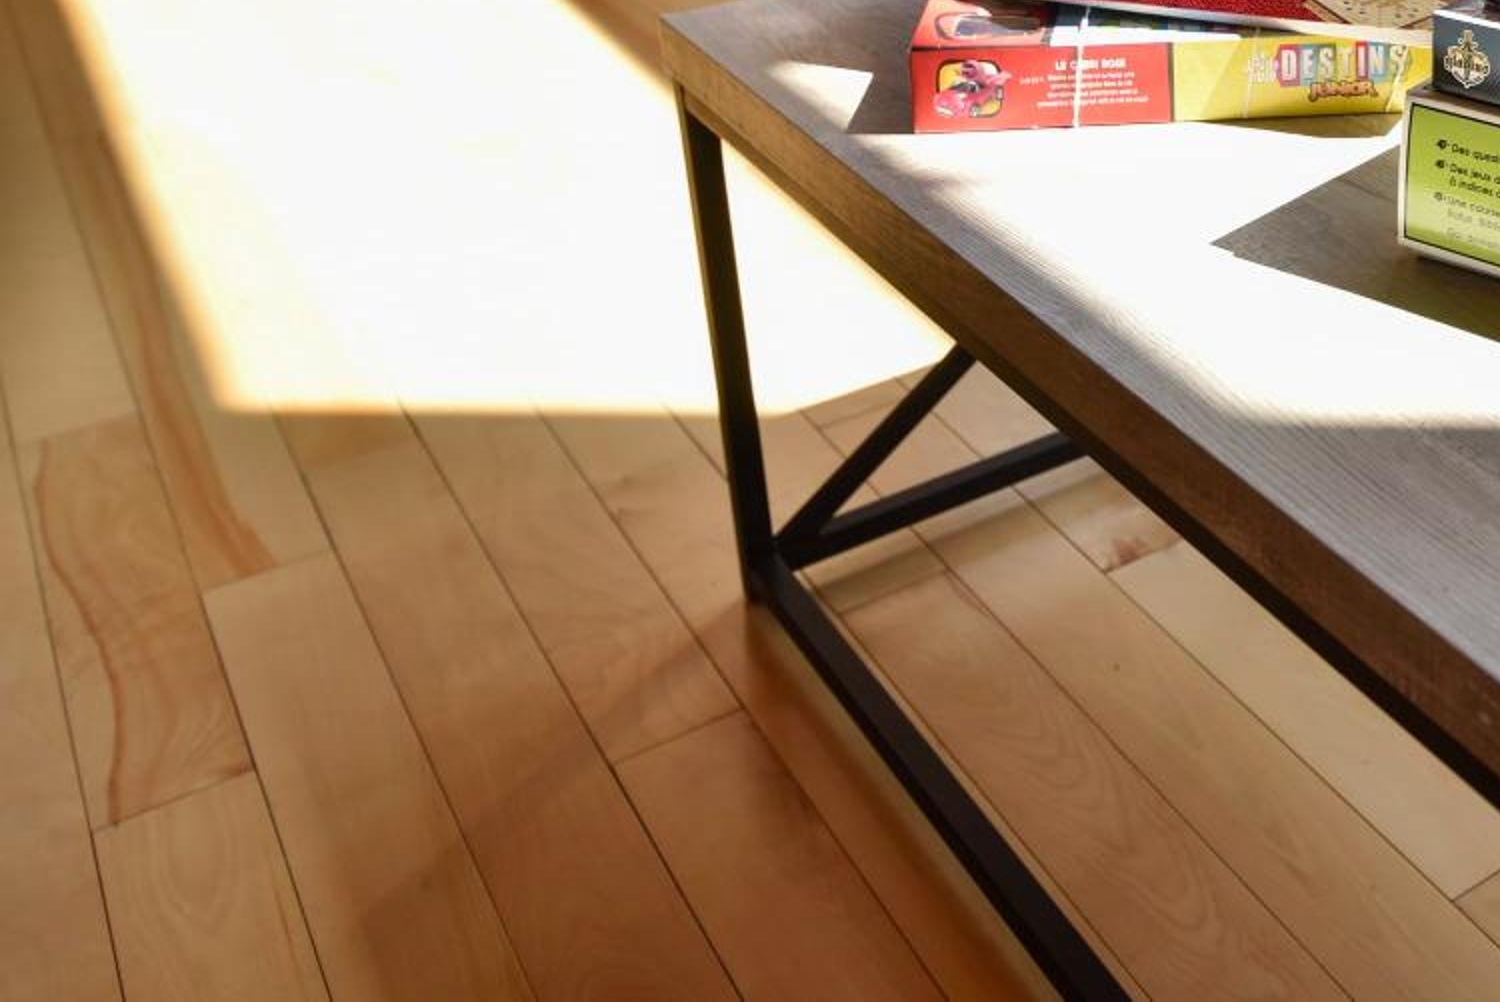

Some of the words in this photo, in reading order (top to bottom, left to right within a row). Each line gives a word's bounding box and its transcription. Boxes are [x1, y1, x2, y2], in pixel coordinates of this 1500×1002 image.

[1280, 42, 1411, 84] DESTINS
[1451, 143, 1470, 156] Des
[1449, 163, 1468, 176] Des
[1470, 169, 1491, 183] jeux
[1458, 180, 1494, 198] indices
